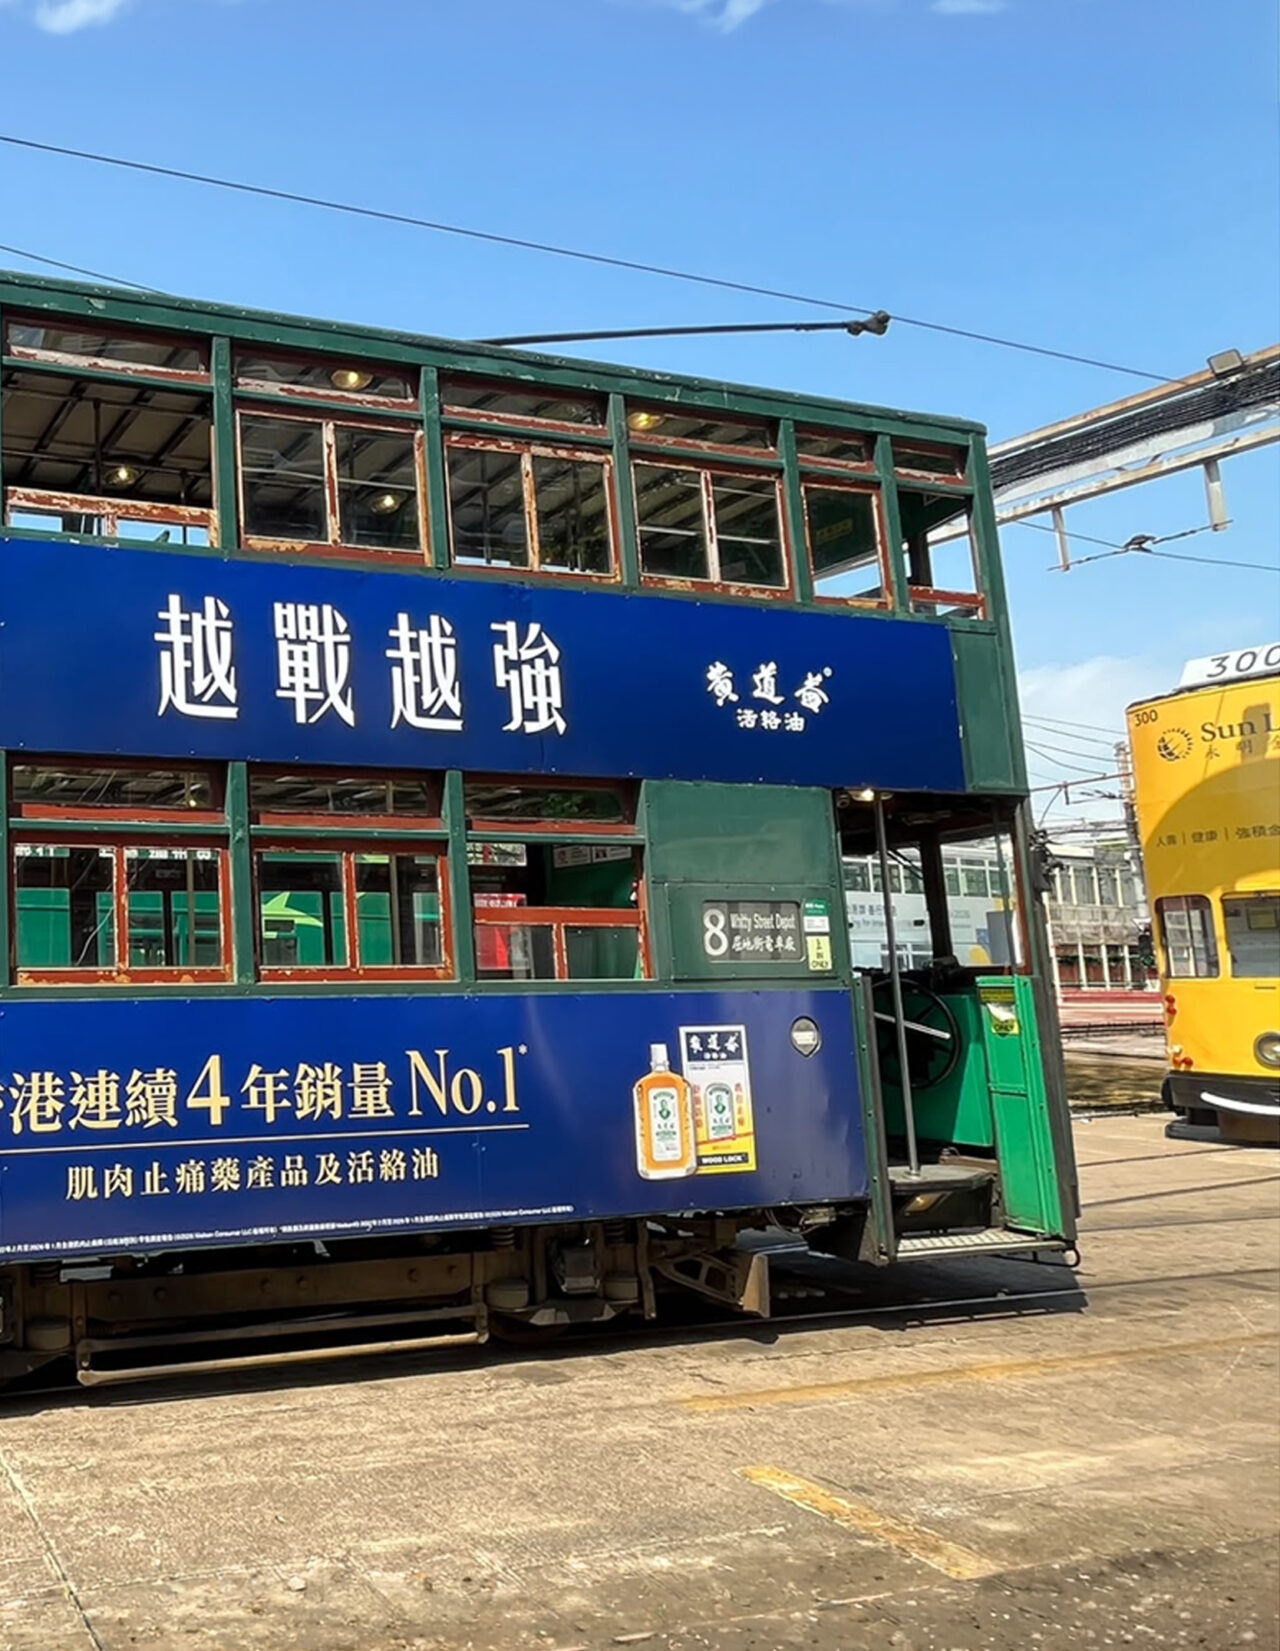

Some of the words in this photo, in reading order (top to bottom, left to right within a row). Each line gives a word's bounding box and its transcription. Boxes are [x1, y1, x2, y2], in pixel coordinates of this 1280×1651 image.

[153, 594, 568, 736] 越戰越強
[736, 707, 806, 733] 活絡油
[1134, 708, 1159, 728] 300
[1201, 721, 1257, 742] Sun
[703, 908, 729, 956] 8
[65, 1147, 440, 1201] 肌肉止痛藥產品及活絡油
